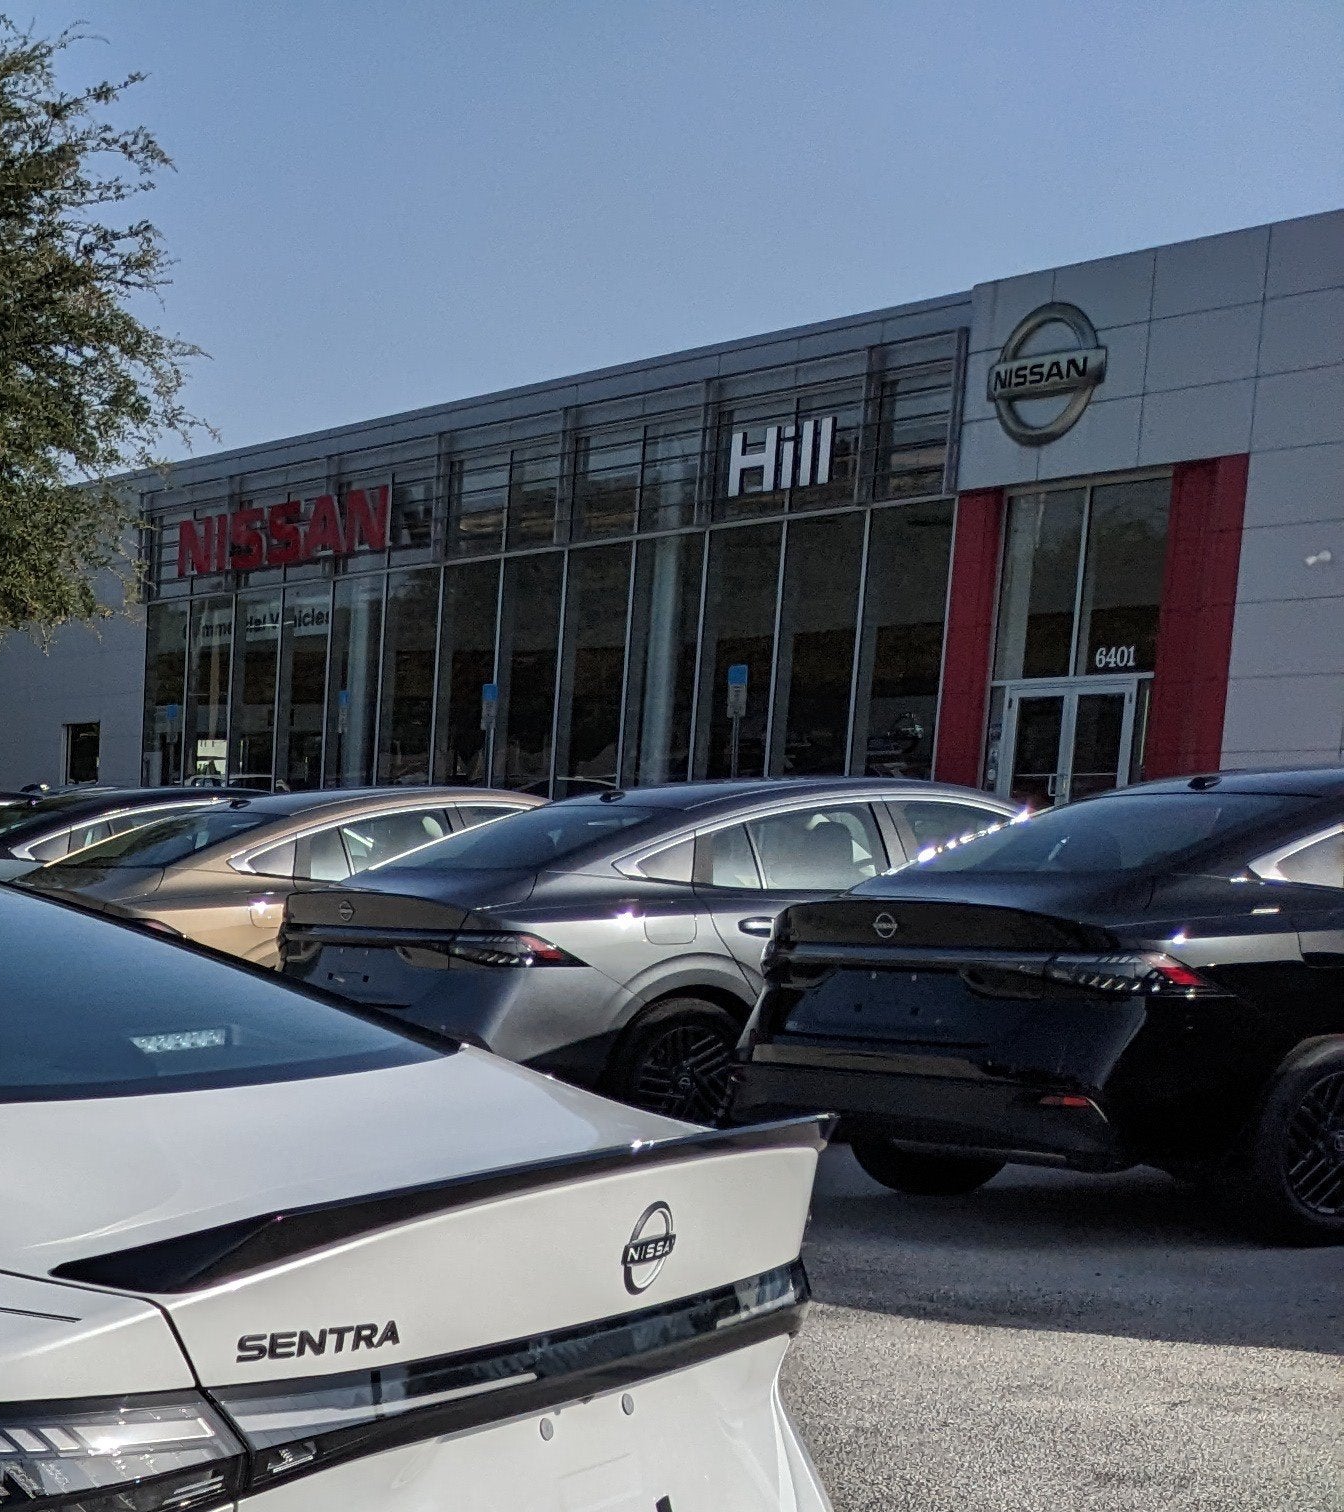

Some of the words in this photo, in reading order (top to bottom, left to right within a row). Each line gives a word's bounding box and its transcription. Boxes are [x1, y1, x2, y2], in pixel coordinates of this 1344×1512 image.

[992, 355, 1090, 391] NISSAN
[727, 416, 837, 497] Hill
[176, 485, 390, 578] NISSAN
[1095, 645, 1136, 669] 6401
[236, 1319, 401, 1364] SENTRA
